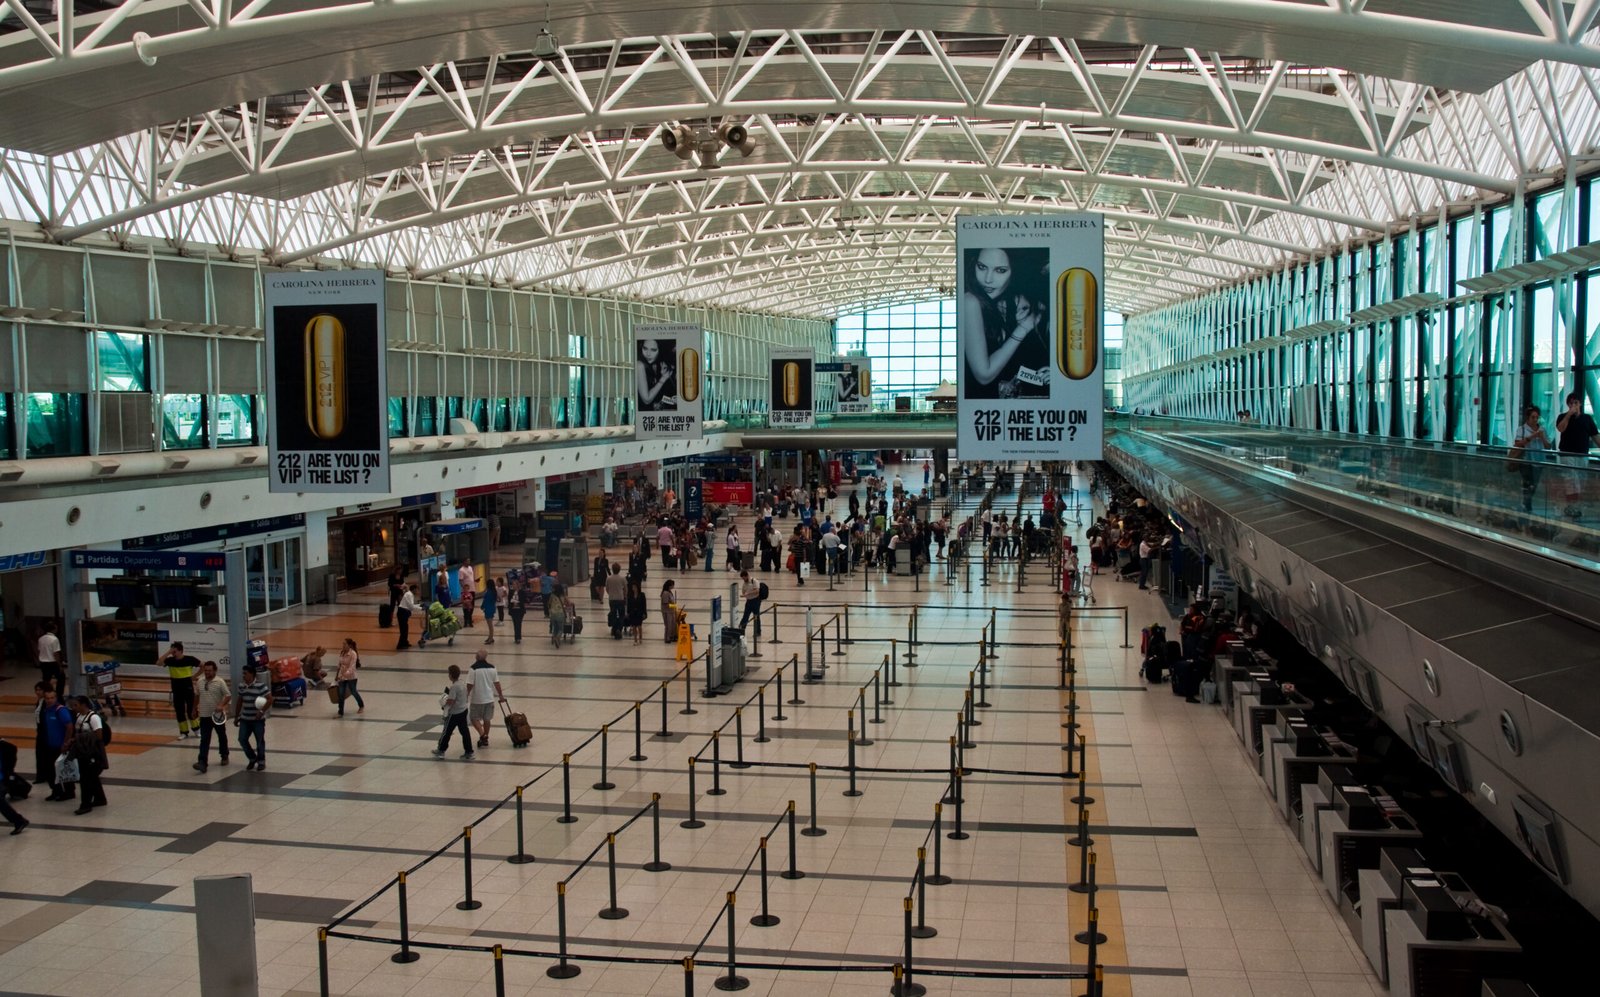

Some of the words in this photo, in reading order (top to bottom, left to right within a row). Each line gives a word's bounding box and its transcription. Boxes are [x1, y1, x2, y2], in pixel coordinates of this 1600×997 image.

[962, 220, 1029, 230] CAROLINA
[1034, 220, 1096, 229] HERRERA
[272, 280, 324, 288] CAROLINA
[327, 279, 376, 287] HERRERA
[1070, 310, 1082, 326] VIP
[1070, 329, 1082, 351] 212
[319, 360, 331, 380] VIP
[319, 383, 332, 407] 212
[974, 410, 1000, 425] 212
[1008, 411, 1034, 424] ARE
[1038, 410, 1065, 424] YOU
[1069, 410, 1087, 424] ON
[643, 424, 655, 432] VIP
[975, 426, 1002, 441] VIP
[1008, 427, 1034, 441] THE
[1036, 427, 1063, 441] LIST
[278, 454, 301, 468] 212
[308, 454, 331, 467] ARE
[334, 453, 359, 467] YOU
[364, 453, 380, 467] ON
[279, 469, 302, 484] VIP
[308, 470, 332, 484] THE
[334, 470, 359, 484] LIST
[163, 533, 180, 542] Salida
[87, 556, 119, 564] Partidas
[124, 557, 162, 565] Departures
